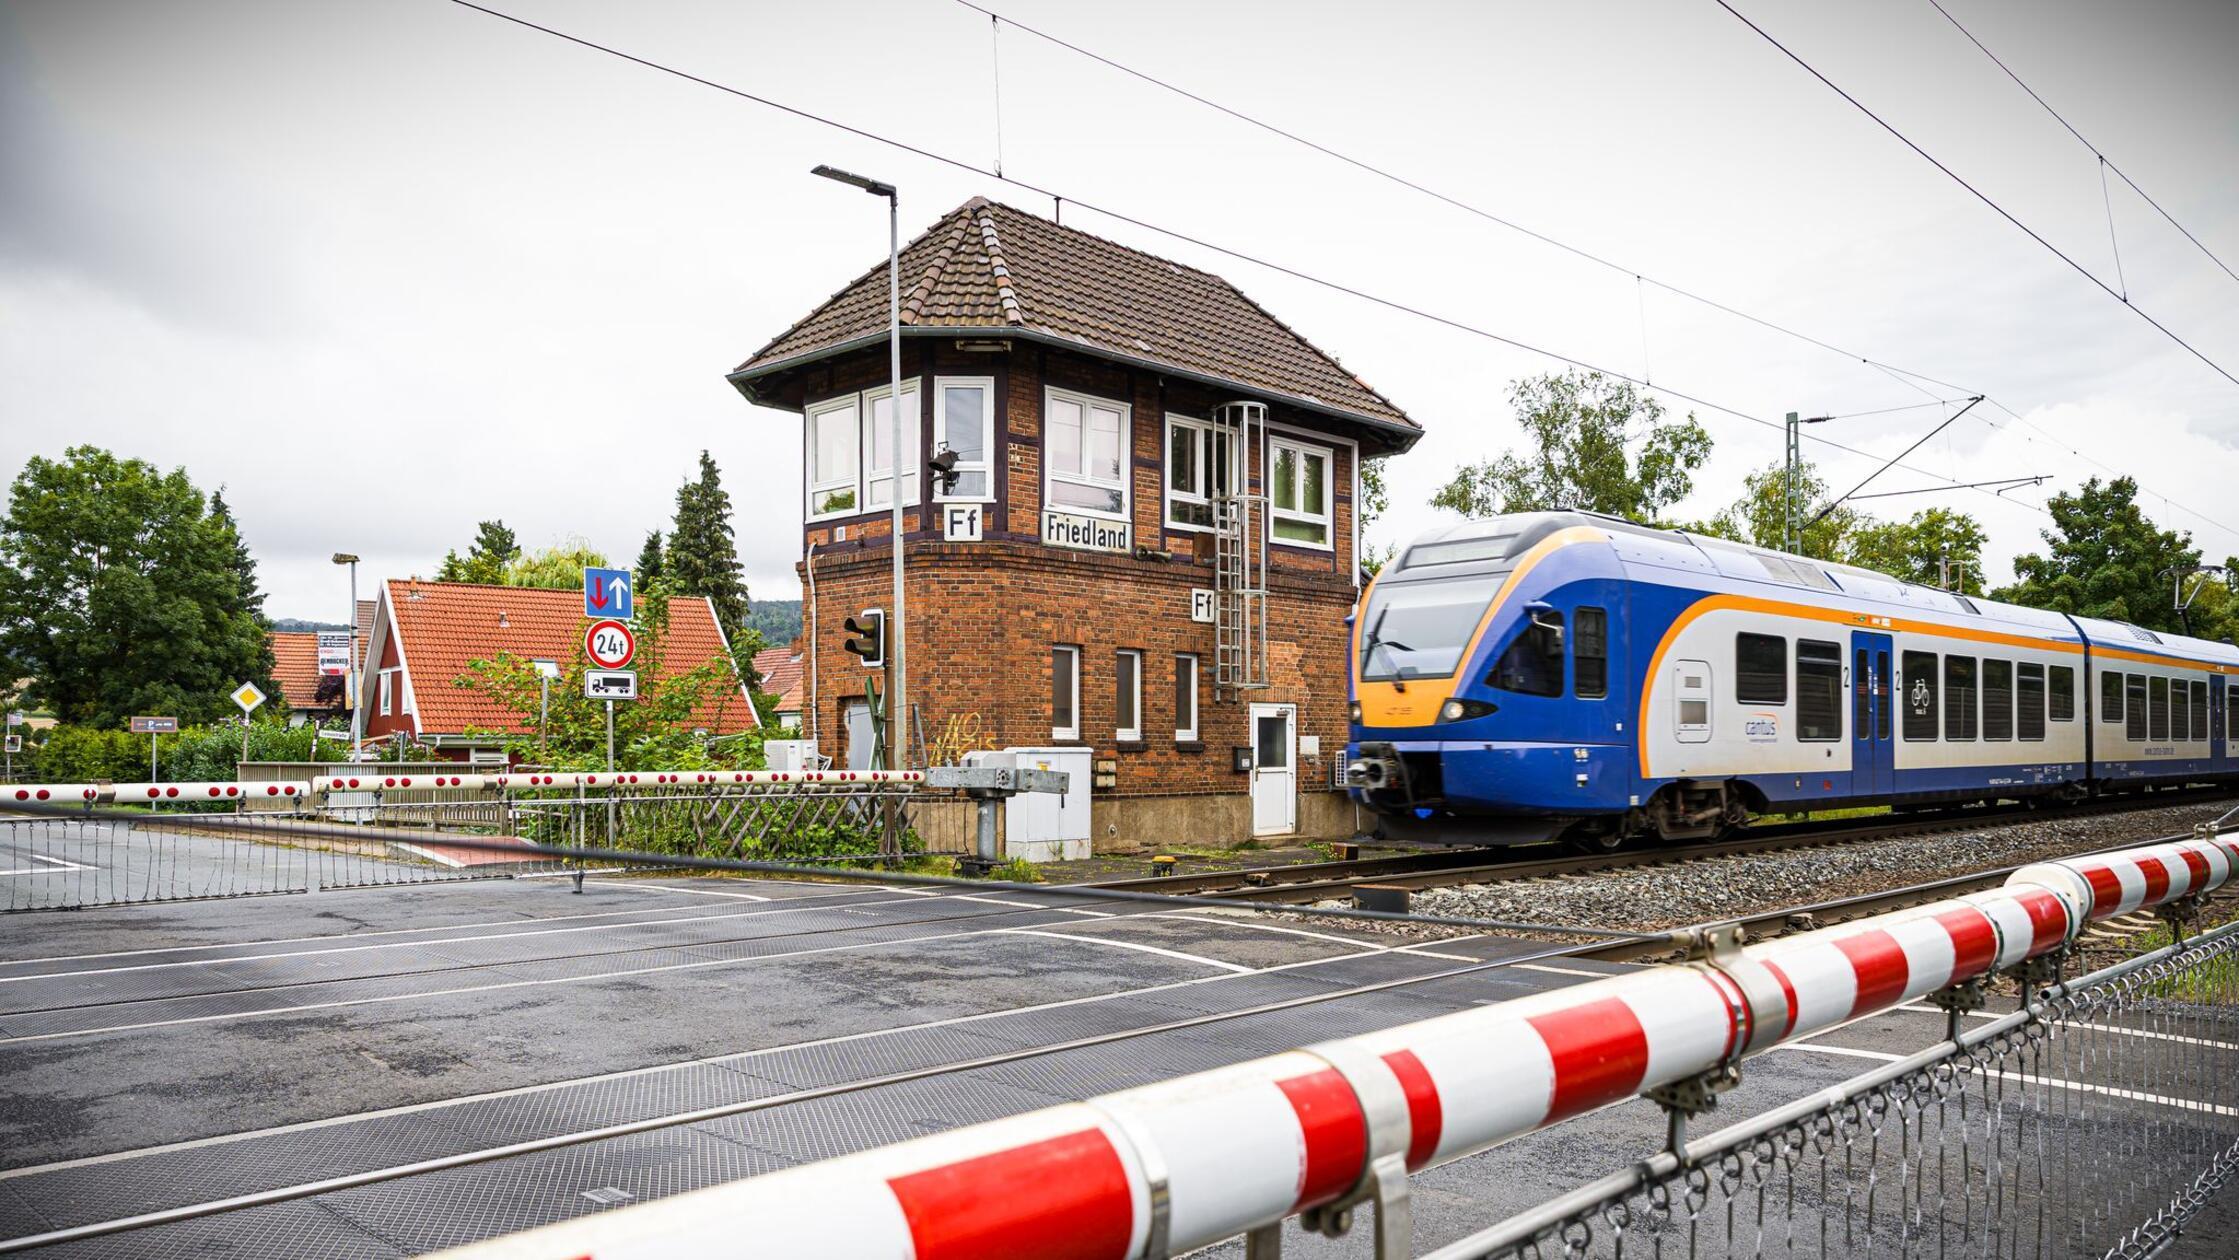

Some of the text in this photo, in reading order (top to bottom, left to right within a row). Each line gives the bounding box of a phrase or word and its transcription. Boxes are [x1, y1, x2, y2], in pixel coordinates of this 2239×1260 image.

[949, 508, 977, 537] Ff
[1047, 514, 1127, 550] Friedland
[1195, 592, 1212, 618] Ff
[1843, 666, 1850, 688] 2
[1895, 670, 1901, 691] 2
[942, 712, 981, 749] NO
